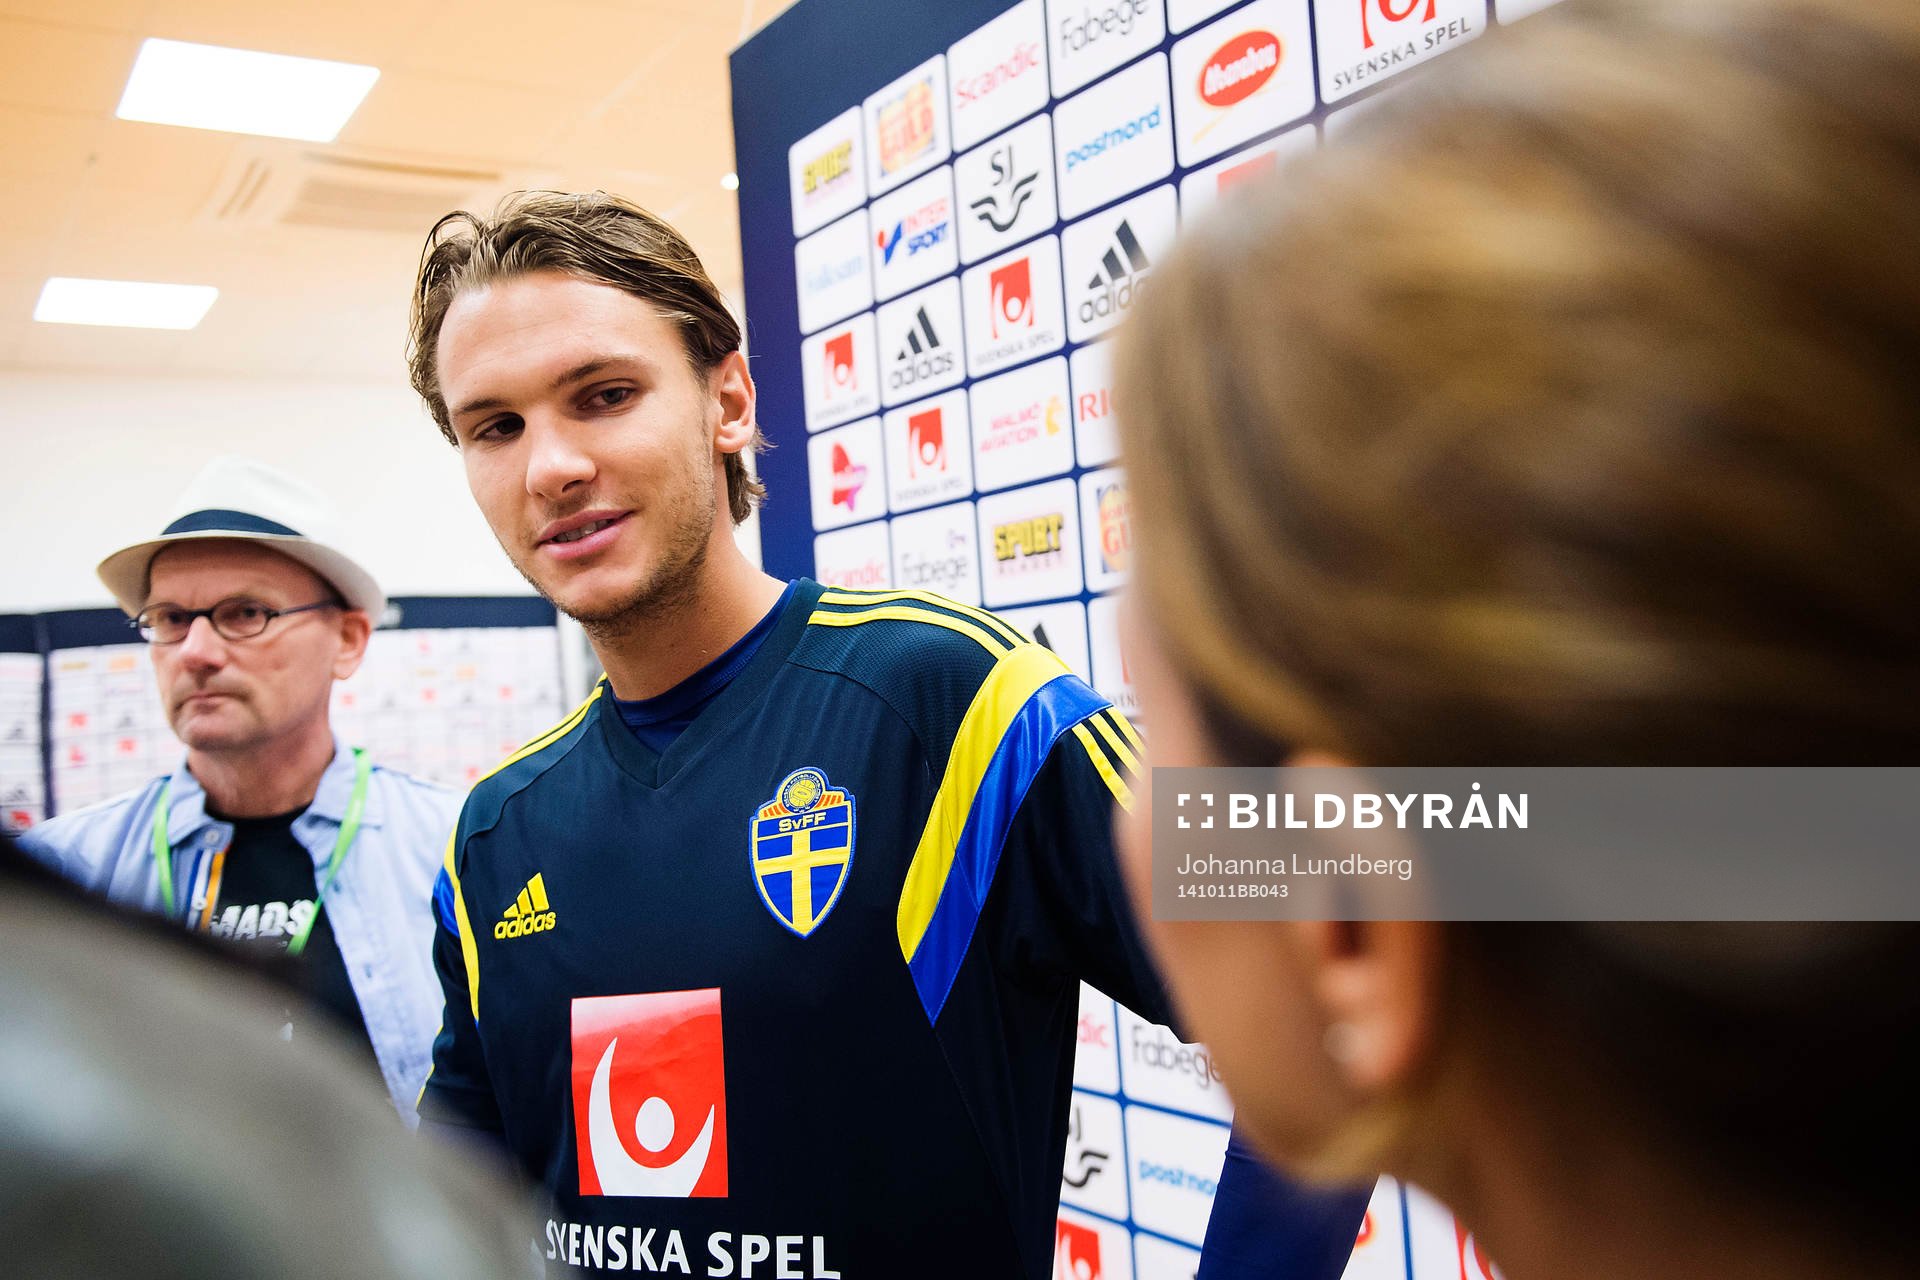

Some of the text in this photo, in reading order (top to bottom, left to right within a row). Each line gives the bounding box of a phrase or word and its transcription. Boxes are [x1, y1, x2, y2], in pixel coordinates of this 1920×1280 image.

[1061, 0, 1148, 57] Fabege
[1334, 17, 1472, 90] SVENSKA SPEL
[956, 42, 1039, 108] Scandic
[1066, 104, 1161, 172] postnord
[889, 350, 954, 390] adidas
[994, 512, 1064, 562] SPORT
[778, 812, 826, 832] SvFF
[494, 909, 557, 940] adidas
[1139, 1160, 1217, 1194] postno
[545, 1218, 841, 1280] SVENSKA SPEL
